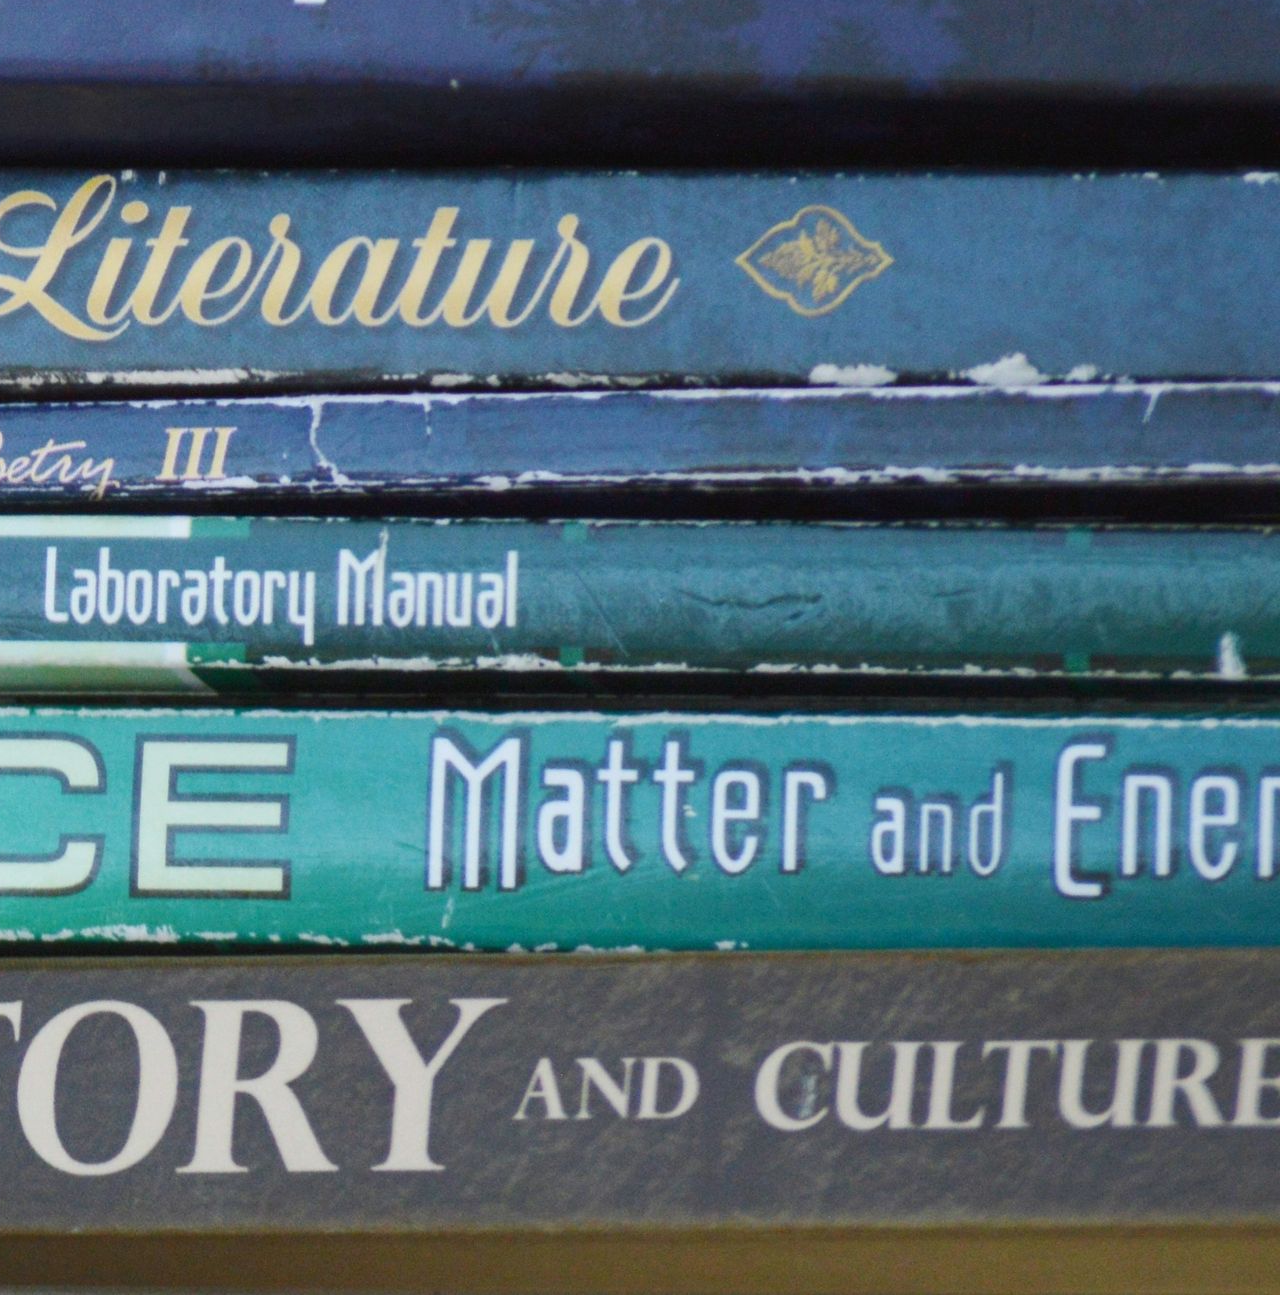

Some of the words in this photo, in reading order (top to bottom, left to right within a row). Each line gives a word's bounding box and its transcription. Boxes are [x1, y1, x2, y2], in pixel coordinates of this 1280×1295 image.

[159, 426, 239, 480] III
[43, 546, 316, 646] Laboratory
[338, 544, 518, 628] Manual
[429, 738, 825, 888] Matter
[871, 773, 1003, 875] and
[515, 1058, 698, 1119] AND
